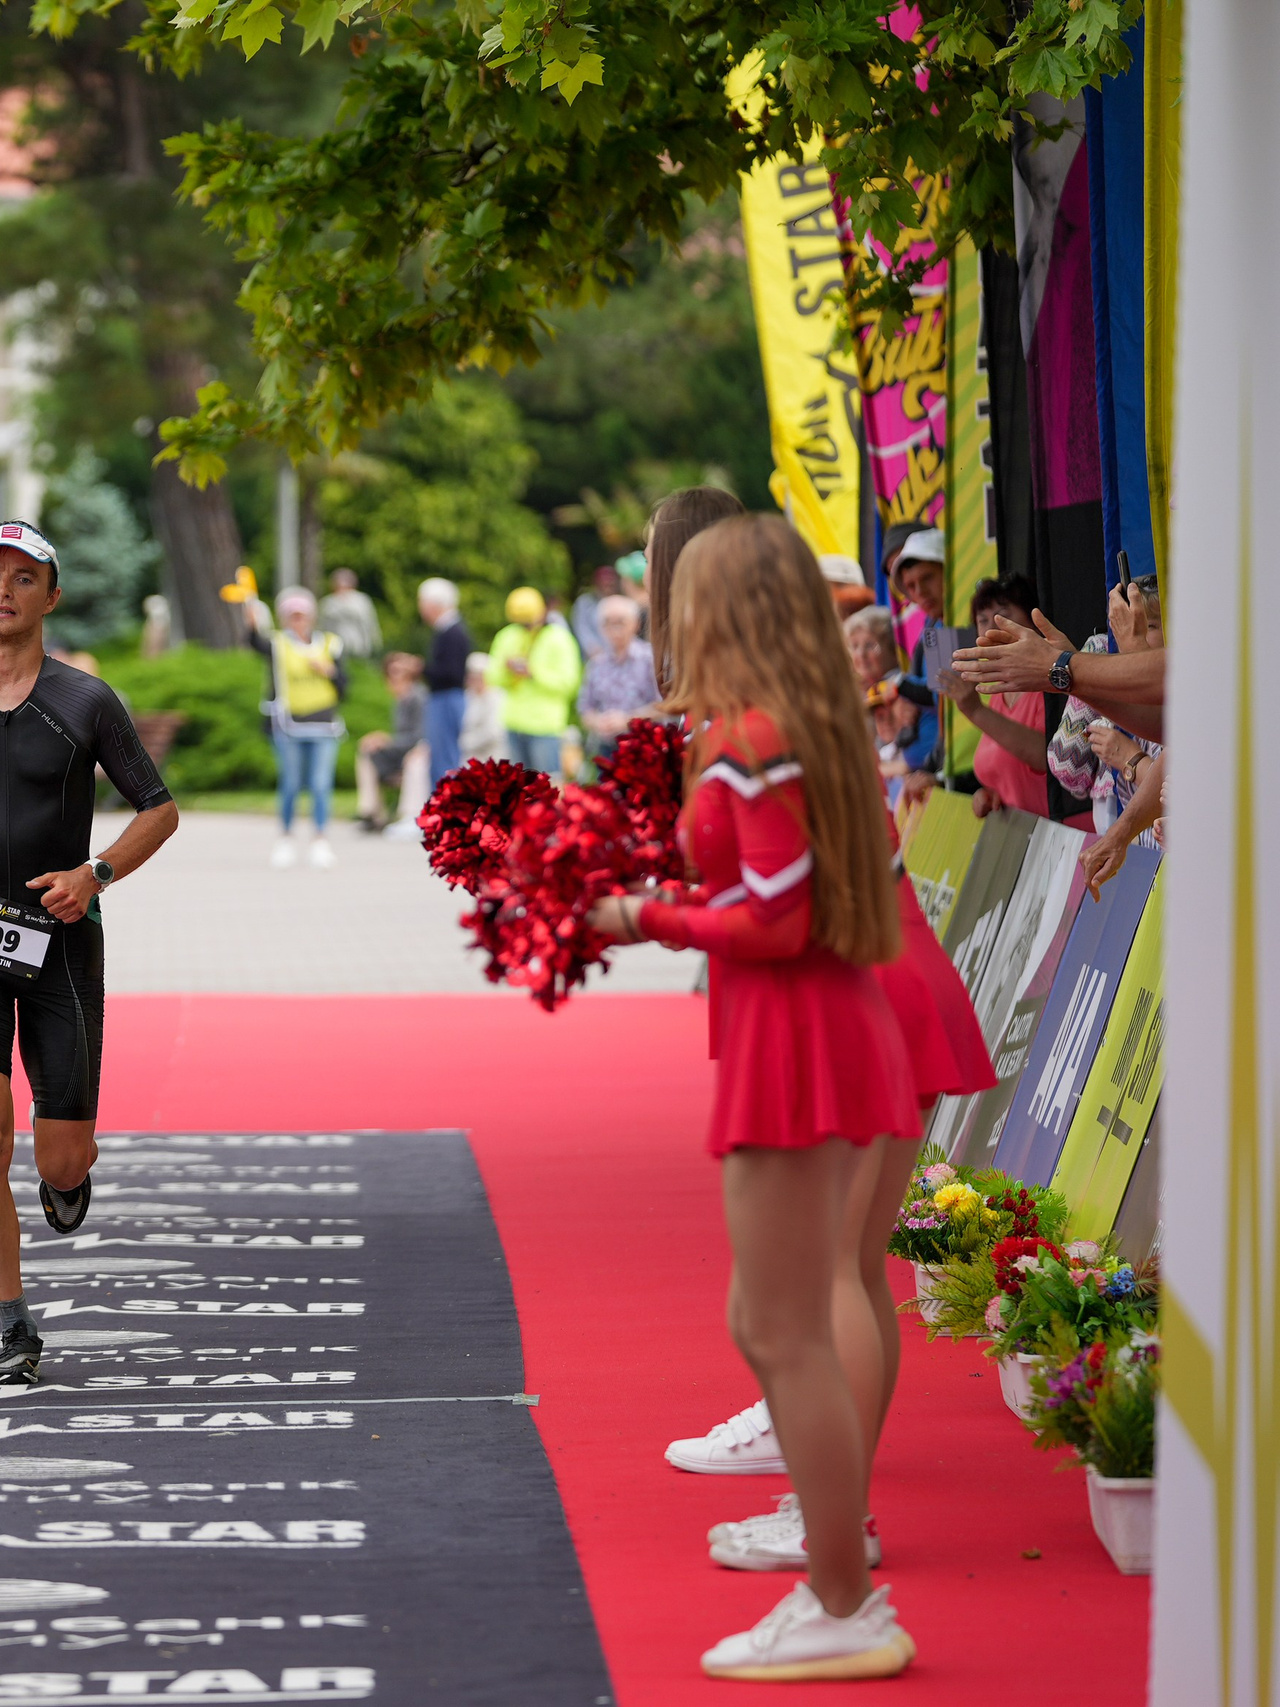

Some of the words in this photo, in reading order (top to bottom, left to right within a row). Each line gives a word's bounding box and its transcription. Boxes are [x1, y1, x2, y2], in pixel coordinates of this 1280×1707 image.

[778, 164, 843, 315] STAR
[41, 713, 63, 734] HUUB
[7, 906, 21, 916] STAR
[1028, 963, 1108, 1136] AVA
[160, 1182, 360, 1193] STAR
[144, 1233, 366, 1246] STAR
[121, 1299, 366, 1313] STAR
[84, 1371, 357, 1387] STAR
[66, 1410, 355, 1428] STAR
[36, 1520, 366, 1541] STAR
